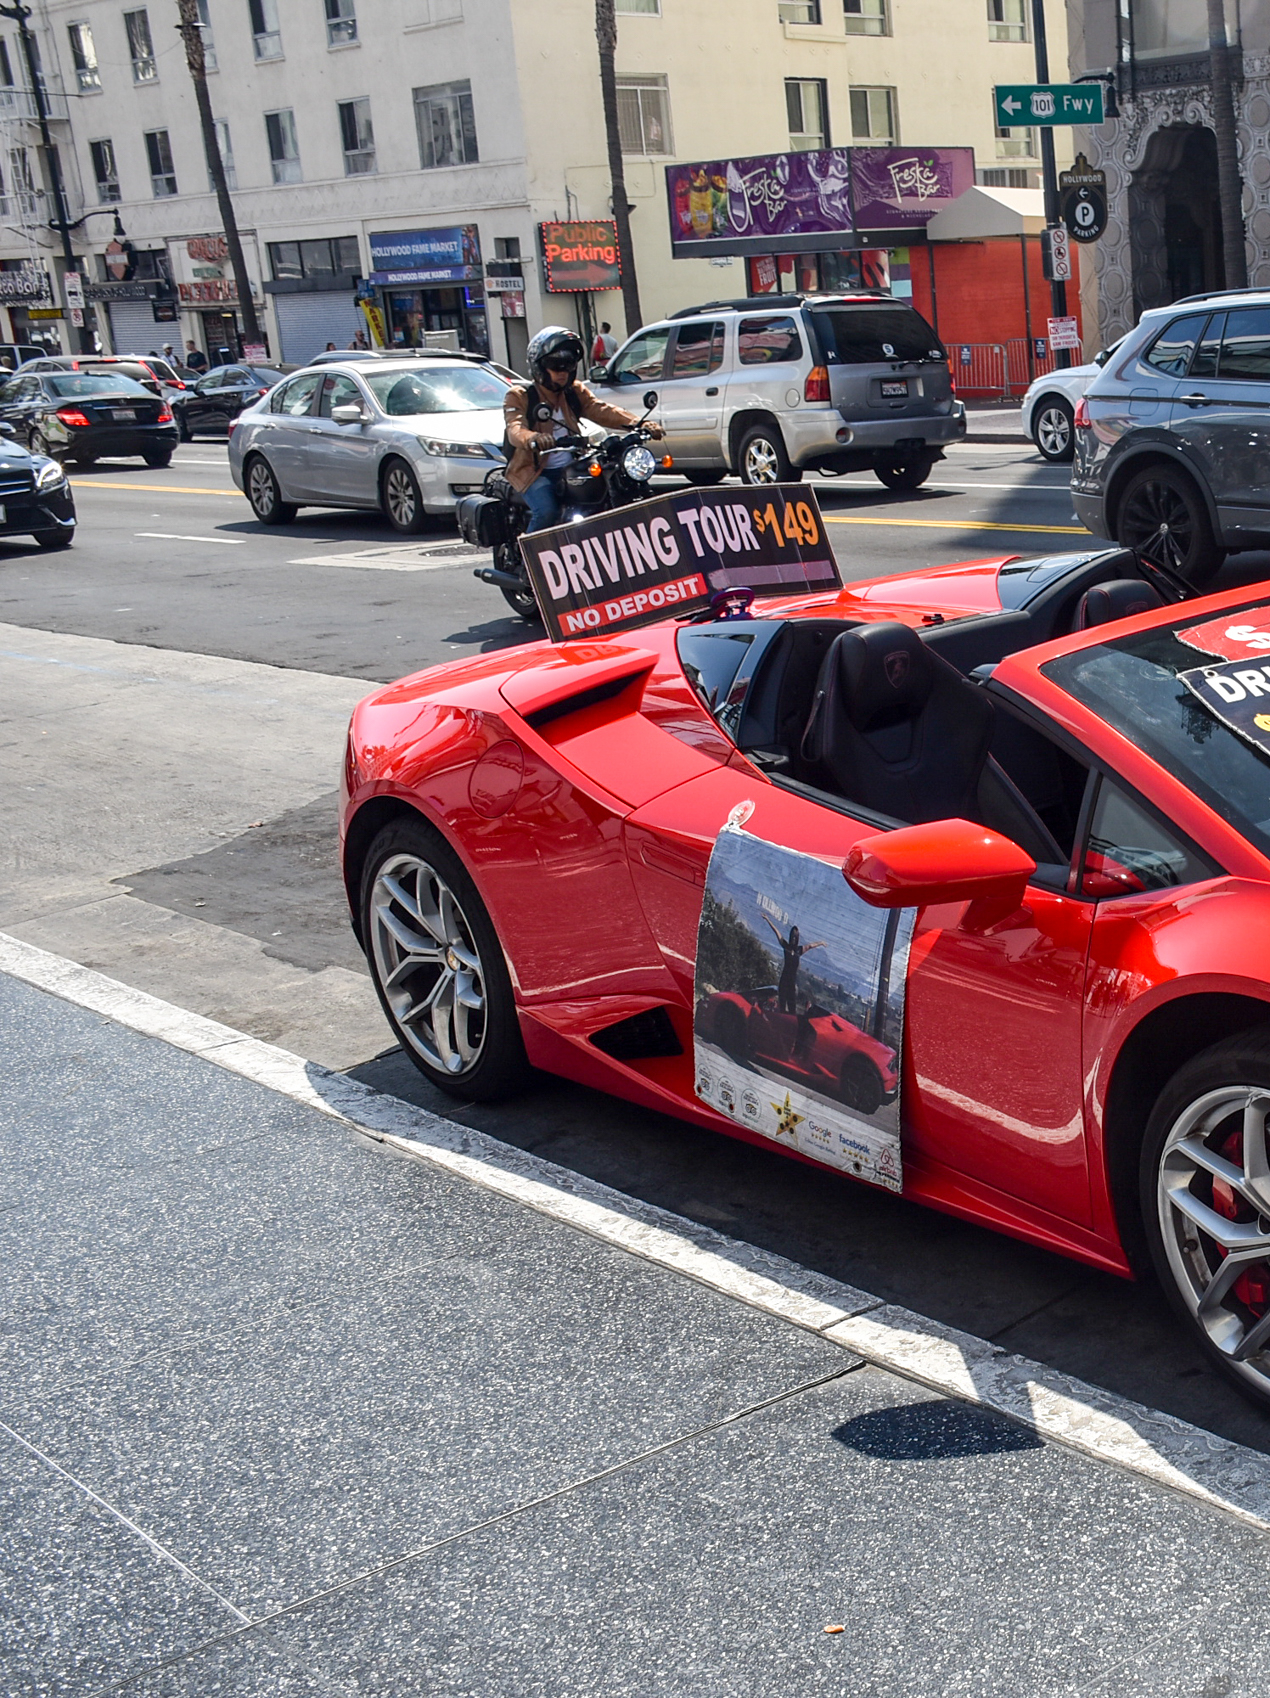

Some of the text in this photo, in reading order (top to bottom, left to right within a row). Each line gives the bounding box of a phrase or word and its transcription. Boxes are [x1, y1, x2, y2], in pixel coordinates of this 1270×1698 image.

[1035, 95, 1094, 115] 101 Fwy
[887, 157, 938, 203] Freska
[1062, 175, 1102, 184] HOLLYWOOD
[740, 167, 785, 225] Freska
[917, 183, 940, 201] Bar
[763, 200, 787, 222] Bar
[1081, 205, 1090, 222] P
[549, 223, 607, 243] Public
[1073, 225, 1100, 237] PARKING
[371, 241, 458, 257] HOLLYWOOD FAME MARKET
[547, 242, 616, 265] Parking
[387, 269, 452, 282] HOLLYWOOD FAME MARKET
[495, 279, 522, 289] HOSTEL
[760, 269, 777, 287] FRUIT
[538, 500, 820, 600] DRIVING TOUR $149
[565, 577, 699, 632] NO DEPOSIT
[808, 1120, 832, 1138] Google
[839, 1133, 871, 1155] facebook
[878, 1164, 898, 1177] airbnb
